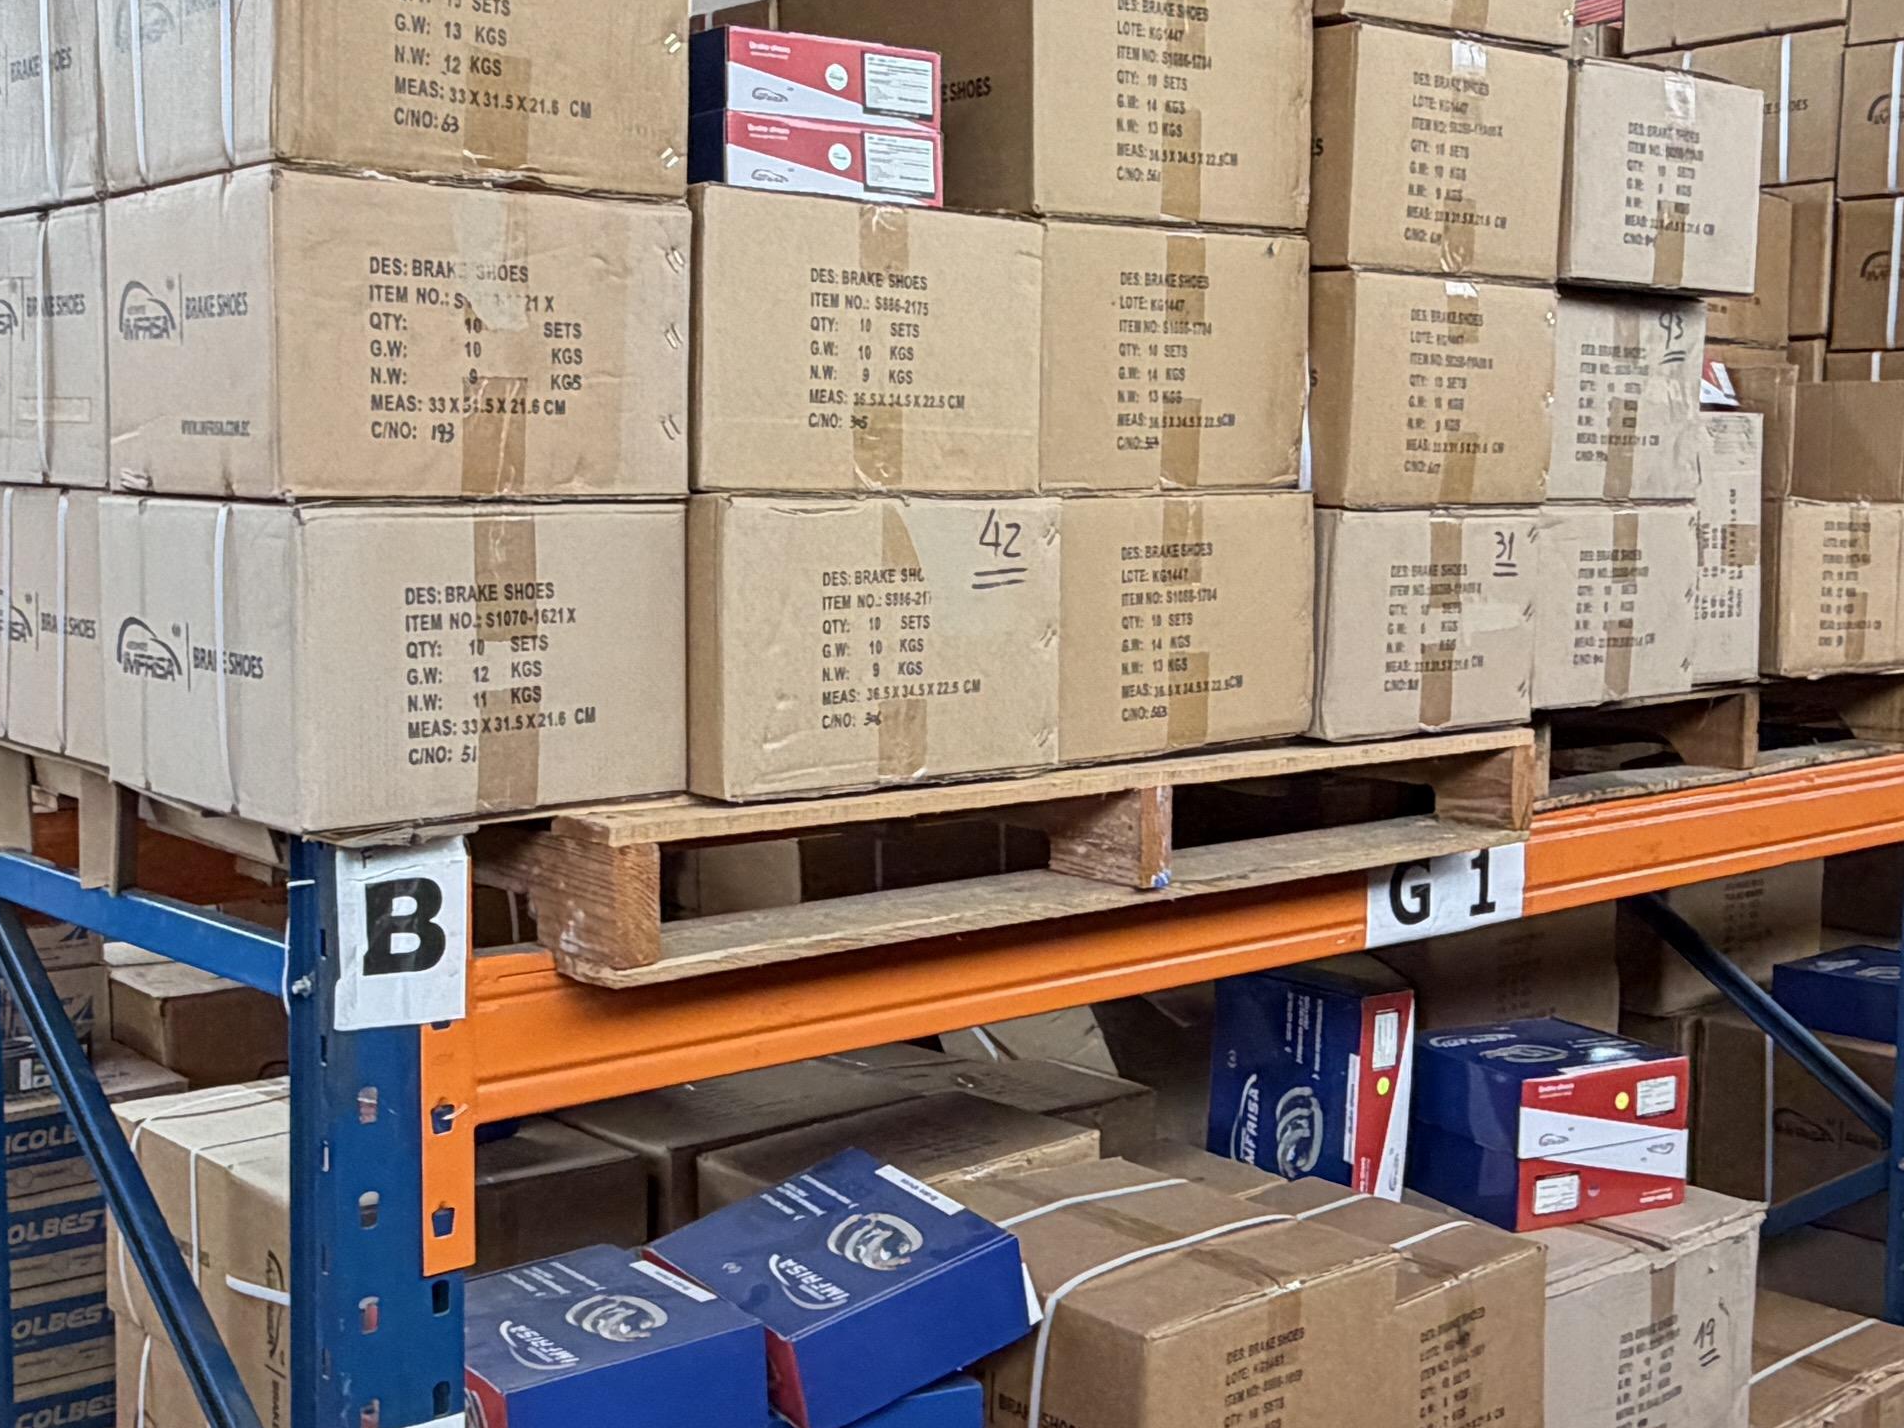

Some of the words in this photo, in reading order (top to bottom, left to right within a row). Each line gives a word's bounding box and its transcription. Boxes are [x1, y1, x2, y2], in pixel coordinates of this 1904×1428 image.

[395, 14, 430, 35] G.W:
[445, 21, 461, 40] 13
[475, 26, 507, 47] KGS
[395, 45, 430, 66] N.W:
[470, 56, 502, 77] KGS
[395, 76, 444, 99] MEAS:
[570, 100, 591, 119] CM
[950, 77, 991, 101] SHOES
[395, 107, 438, 129] C/NO:
[370, 257, 408, 275] DES:
[811, 268, 839, 284] DES:
[842, 271, 883, 288] BRAKE
[888, 274, 928, 290] SHOES
[185, 296, 215, 320] BRAKE
[217, 292, 248, 318] SHOES
[369, 285, 408, 303] ITEM
[417, 287, 449, 306] NO.:
[811, 292, 839, 308] ITEM
[370, 312, 407, 331] QTY:
[465, 318, 482, 333] 10
[544, 322, 582, 339] SETS
[811, 317, 838, 332] QTY:
[890, 323, 919, 338] SETS
[370, 340, 407, 358] G.W:
[465, 342, 481, 358] 10
[551, 348, 583, 365] KGS
[890, 346, 914, 360] KGS
[371, 367, 407, 385] N.W:
[551, 375, 582, 390] KGS
[889, 370, 913, 384] KGS
[371, 394, 422, 411] MEAS:
[544, 400, 565, 415] CM
[371, 421, 417, 439] C/NO:
[979, 509, 1021, 558] 42
[823, 571, 851, 586] DES:
[855, 569, 896, 585] BRAKE
[405, 587, 441, 605] DES:
[446, 585, 498, 603] BRAKE
[505, 582, 554, 601] SHOES
[823, 596, 851, 610] ITEM
[405, 614, 442, 632] ITEM
[486, 608, 564, 628] S1070-1621
[823, 619, 850, 634] QTY:
[901, 615, 930, 630] SETS
[406, 641, 442, 659] QTY:
[469, 639, 485, 656] 10
[511, 635, 548, 652] SETS
[900, 639, 924, 653] KGS
[228, 651, 264, 680] SHOES
[407, 668, 442, 685] G.W:
[473, 666, 489, 683] 12
[511, 660, 542, 678] KGS
[898, 661, 923, 675] KGS
[408, 694, 442, 712] N.W:
[473, 691, 487, 708] 11
[511, 686, 541, 704] KGS
[408, 719, 457, 738] MEAS:
[575, 707, 596, 724] CM
[408, 746, 452, 765] C/NO:
[1390, 861, 1432, 926] G
[363, 877, 446, 976] B
